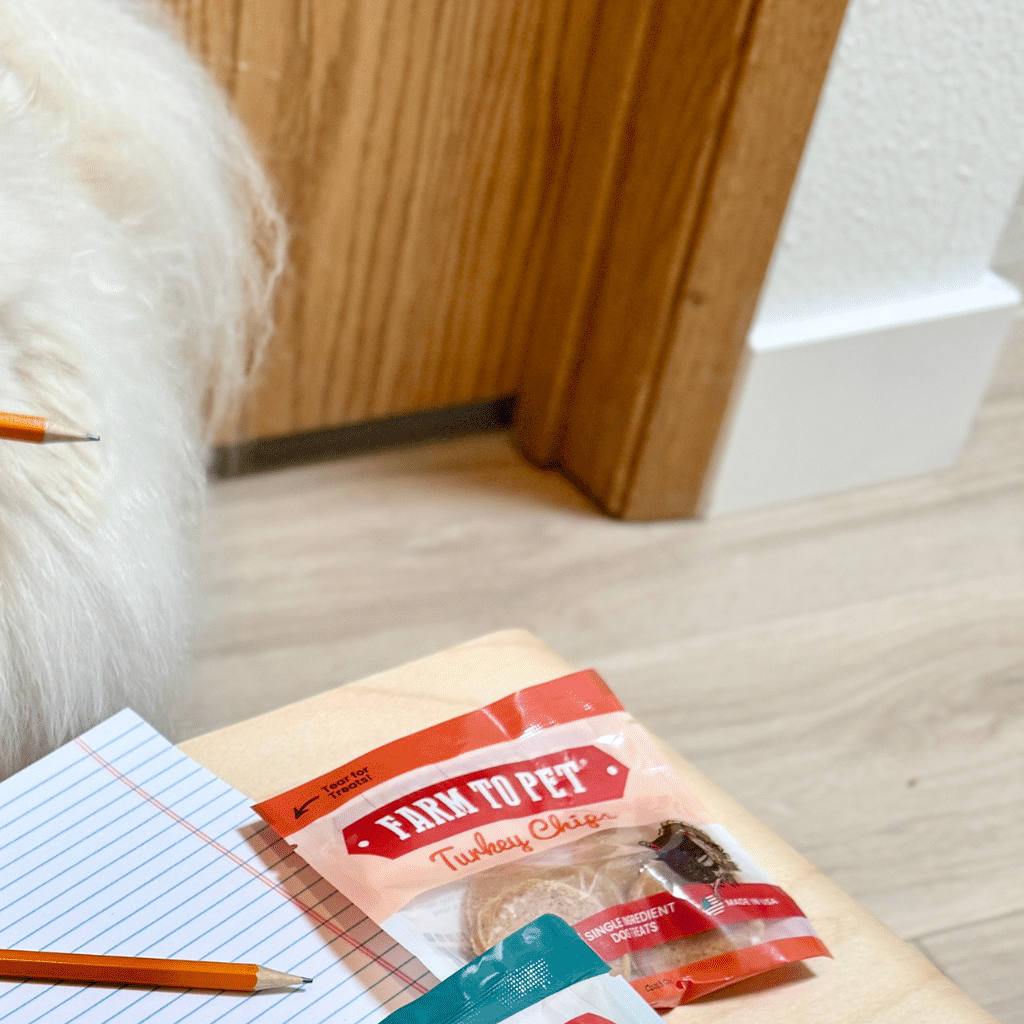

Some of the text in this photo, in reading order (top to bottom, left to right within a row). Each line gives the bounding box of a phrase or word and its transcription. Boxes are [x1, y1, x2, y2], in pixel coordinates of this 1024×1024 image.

[321, 766, 369, 793] Tear for
[328, 774, 373, 799] Treats!
[375, 787, 479, 841] FARM
[467, 775, 521, 809] TO
[428, 831, 534, 872] Turkey
[584, 917, 624, 941] SINGLE
